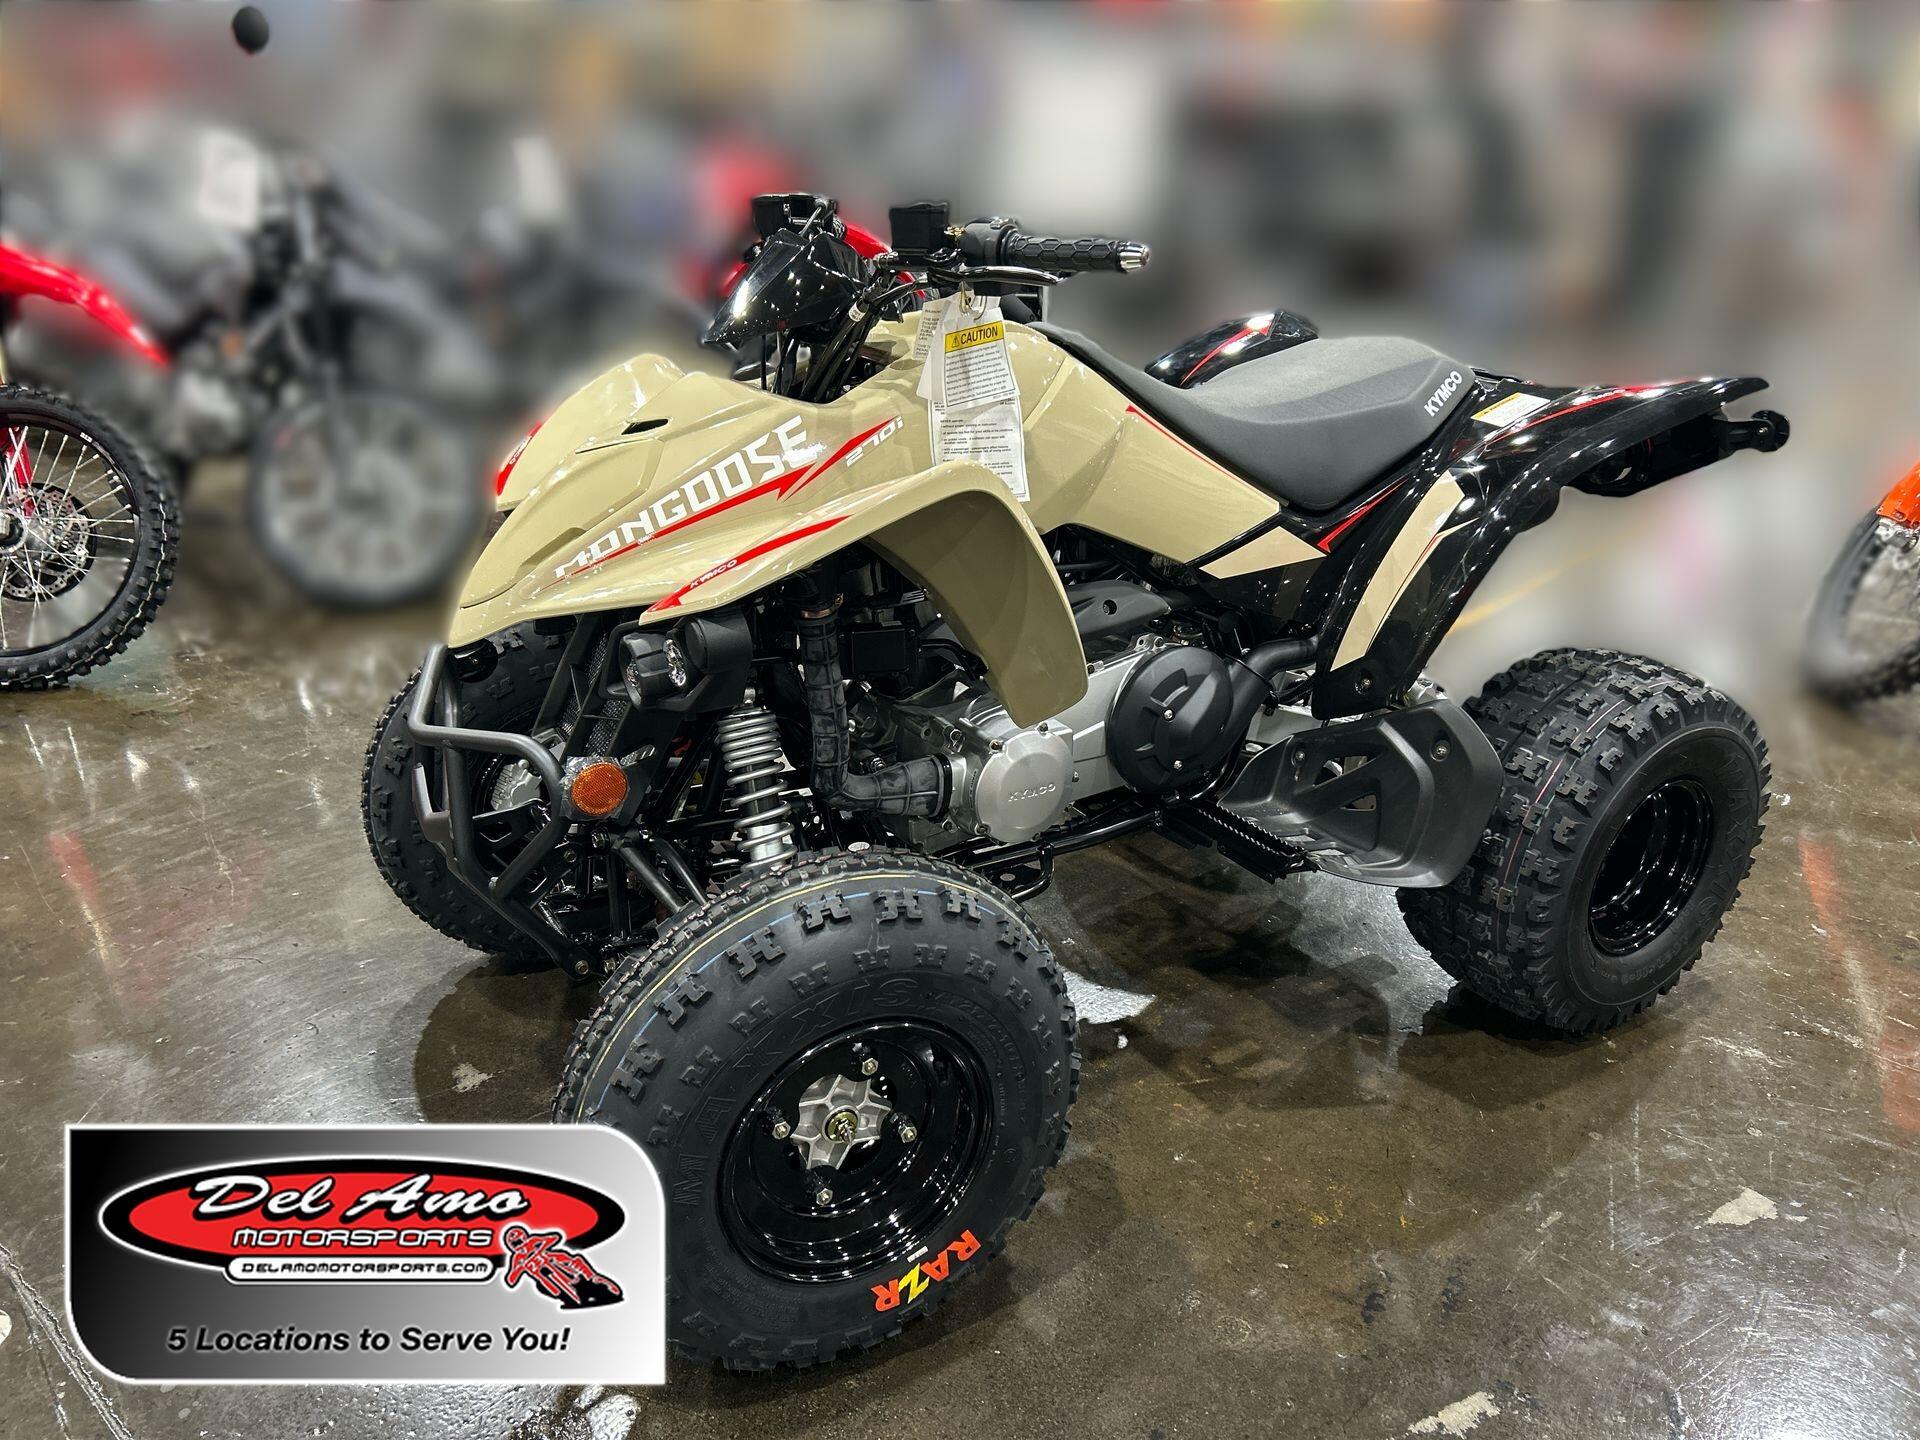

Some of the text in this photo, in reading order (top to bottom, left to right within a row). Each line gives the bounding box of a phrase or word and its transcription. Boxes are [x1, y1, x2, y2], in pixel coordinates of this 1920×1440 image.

[961, 326, 998, 344] CAUTION
[1424, 371, 1463, 416] KYMCO
[845, 416, 904, 467] 270i
[554, 415, 818, 578] MONGOOSE
[690, 559, 738, 588] KYMCO
[871, 1230, 981, 1312] RAZR
